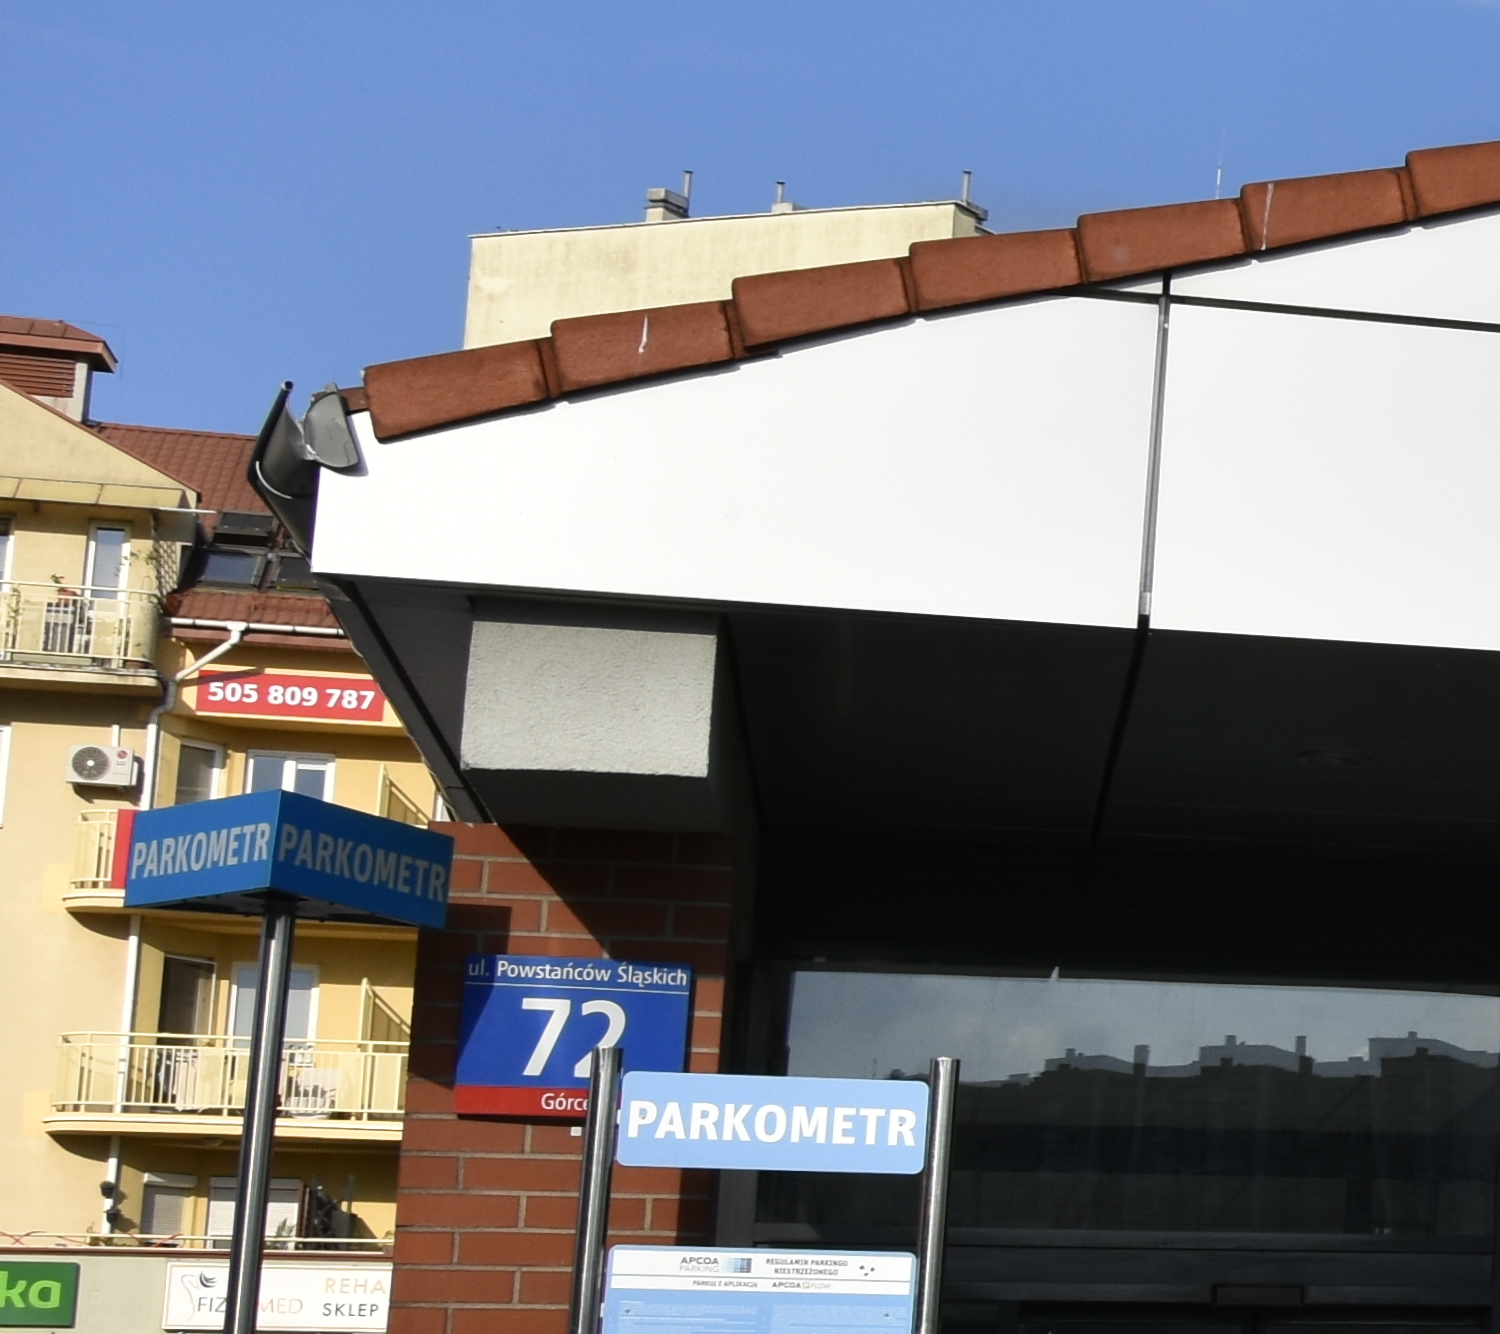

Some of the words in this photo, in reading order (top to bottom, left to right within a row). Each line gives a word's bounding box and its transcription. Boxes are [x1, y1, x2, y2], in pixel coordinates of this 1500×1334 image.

[207, 682, 258, 703] 505
[267, 685, 318, 707] 809
[325, 688, 375, 710] 787
[131, 822, 271, 880] PARKOMETR
[278, 823, 445, 903] PARKOMETR
[468, 962, 490, 977] ul.
[497, 961, 611, 983] Powstańców
[617, 966, 687, 988] Śląskich
[521, 997, 627, 1078] 72
[627, 1100, 917, 1147] PARKOMETR
[322, 1303, 379, 1317] SKLEP
